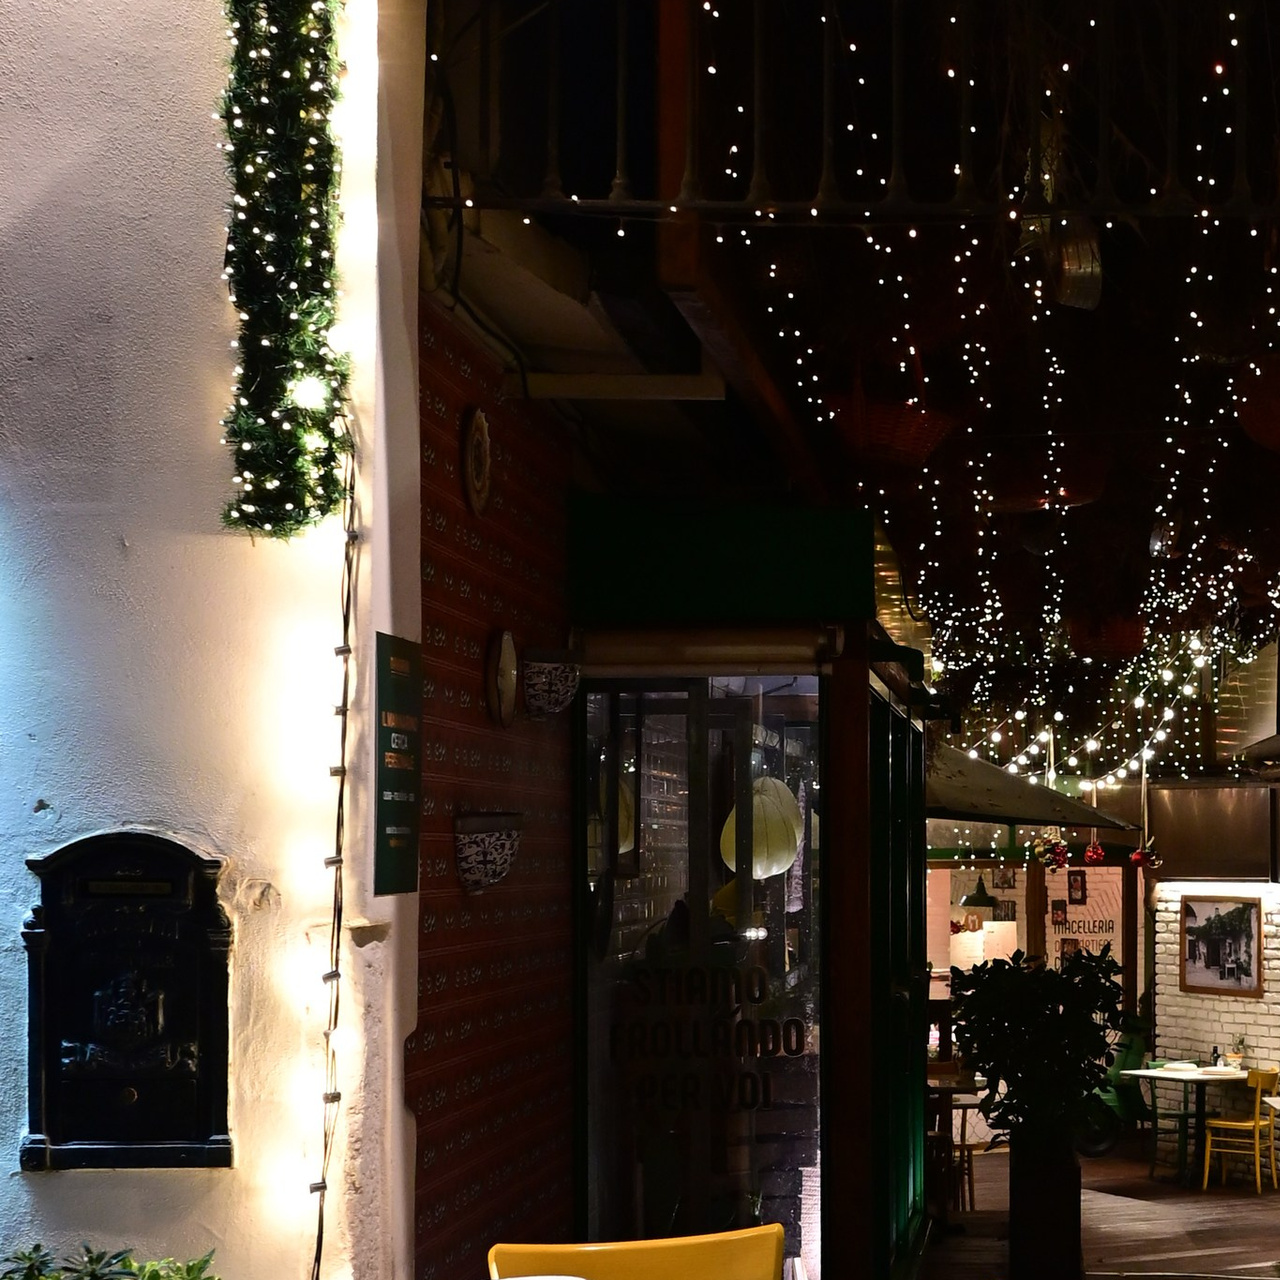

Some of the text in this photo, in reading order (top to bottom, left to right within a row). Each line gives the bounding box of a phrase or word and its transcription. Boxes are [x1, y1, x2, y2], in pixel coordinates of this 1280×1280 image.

[1054, 919, 1115, 935] MACELLERIA
[634, 965, 767, 1005] STIAMO
[636, 1070, 774, 1111] PER VOI
